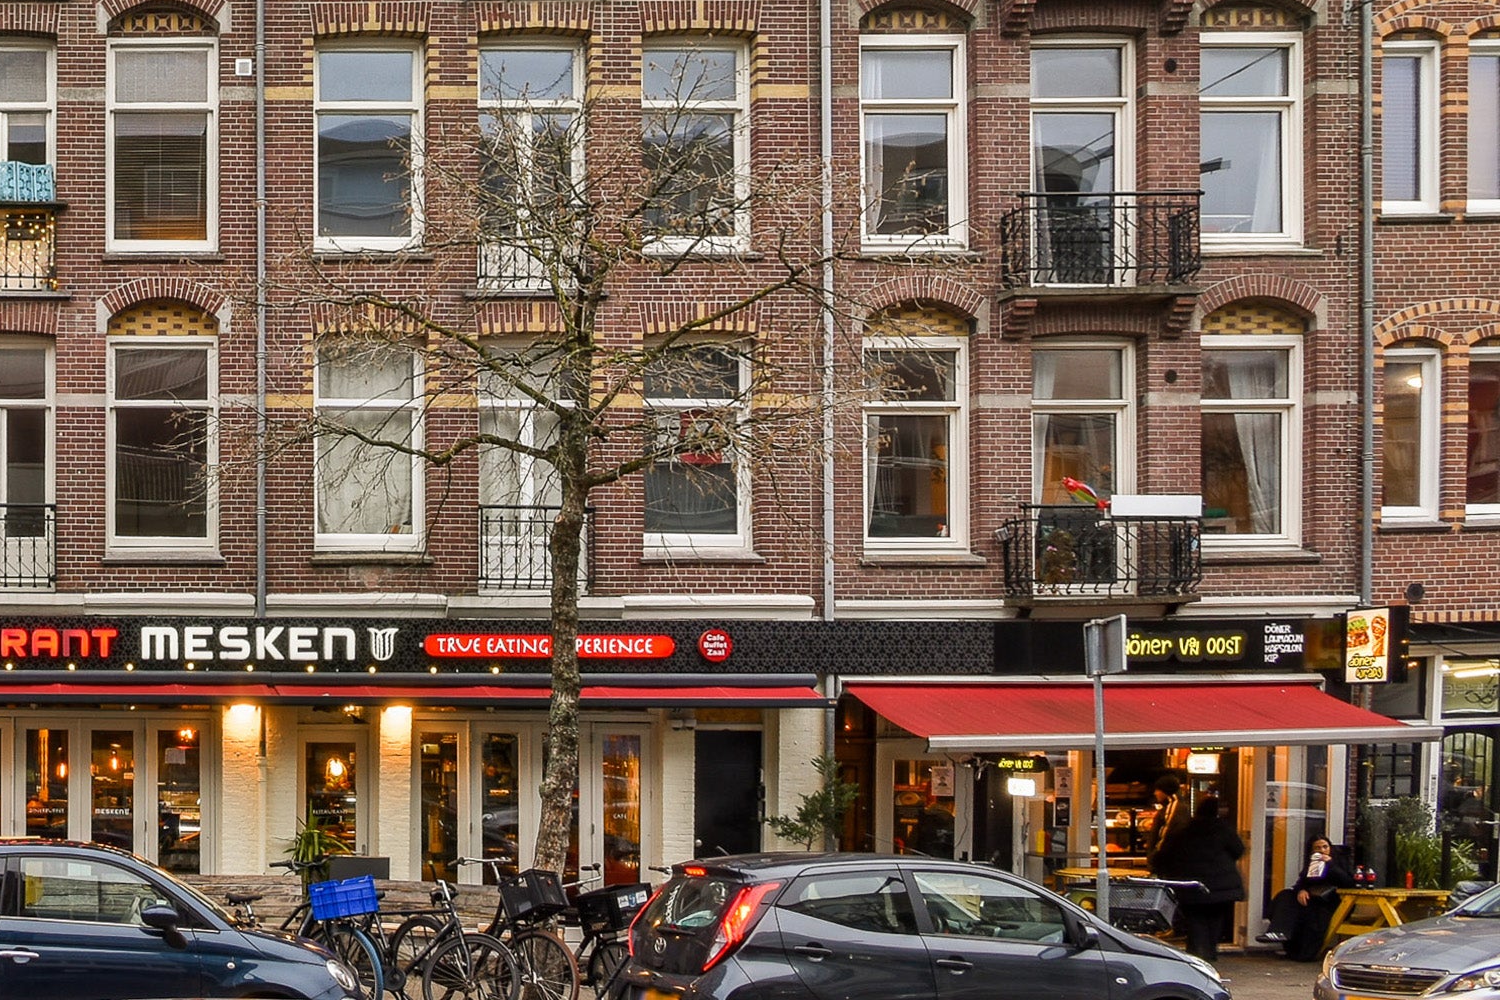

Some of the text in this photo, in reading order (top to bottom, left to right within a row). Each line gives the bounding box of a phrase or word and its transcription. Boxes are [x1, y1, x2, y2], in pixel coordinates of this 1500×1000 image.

[1264, 622, 1292, 634] DÖNER
[141, 626, 356, 660] MESKEN
[436, 637, 653, 655] TRUE EATING PERIENCE
[703, 641, 728, 649] Buffet
[707, 648, 726, 656] Zaal
[1264, 653, 1280, 663] KIP
